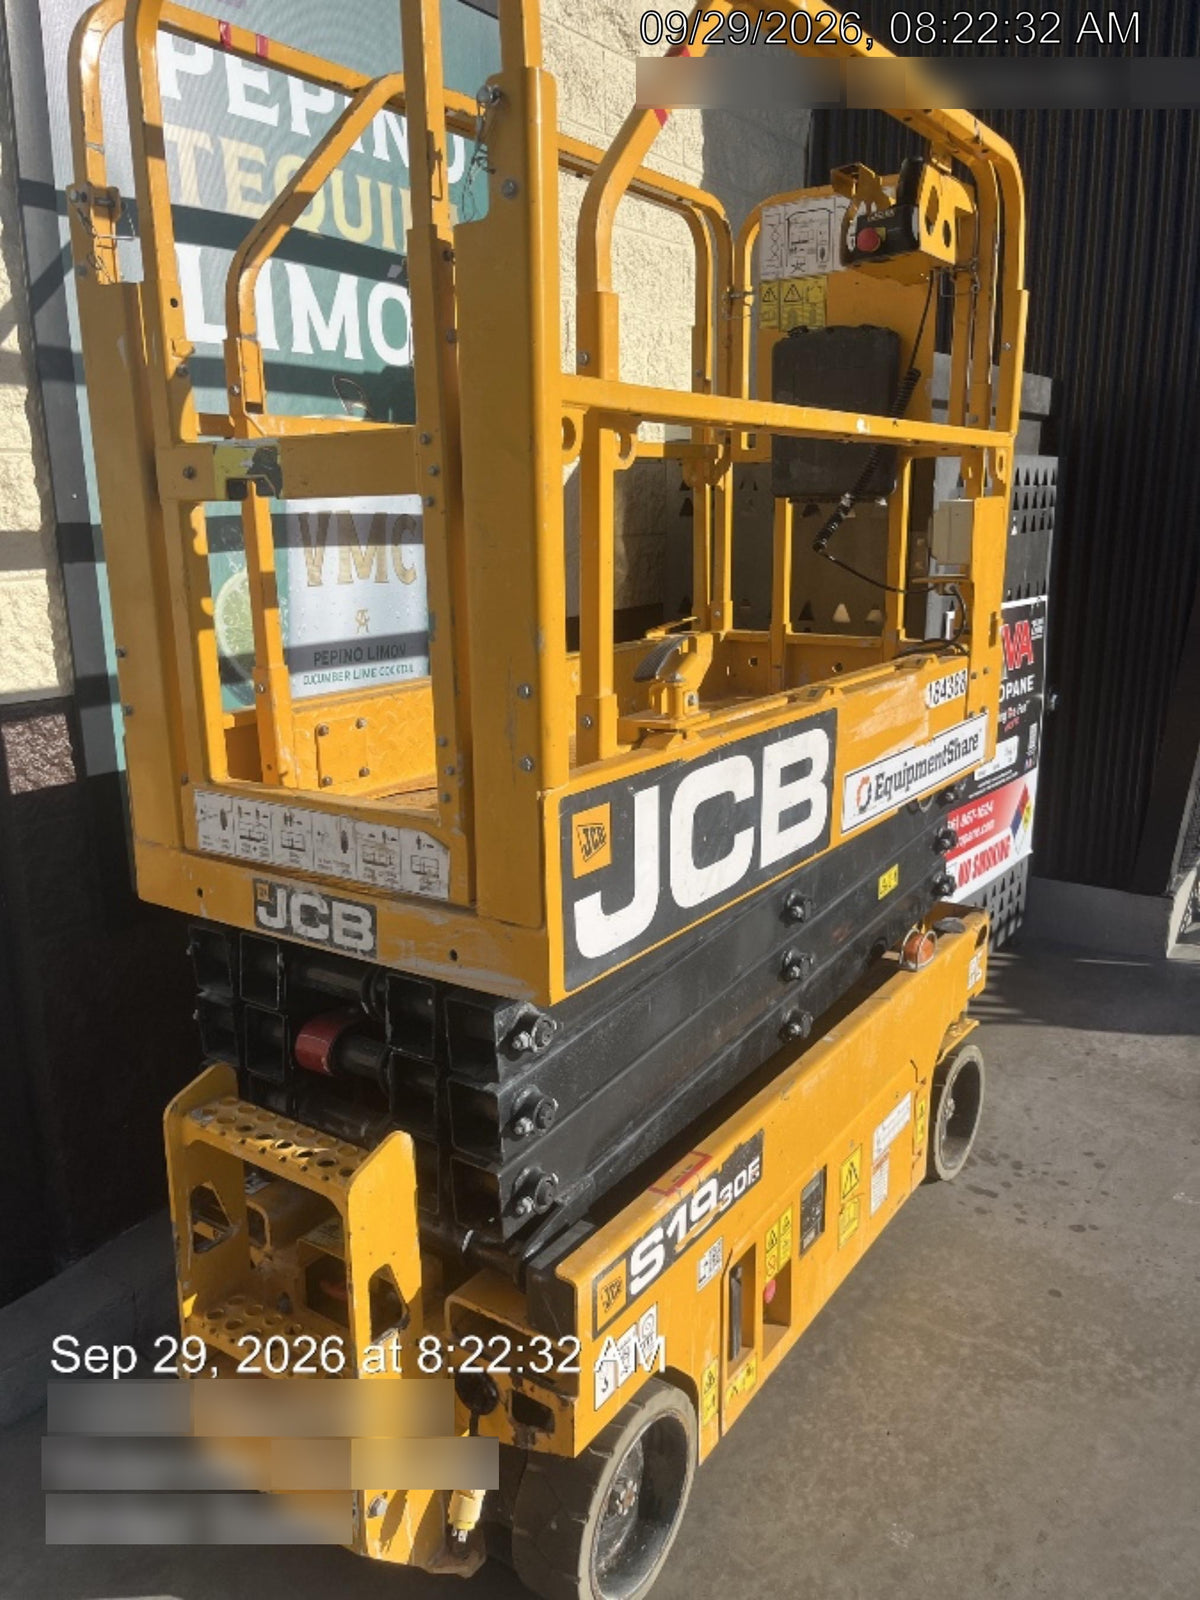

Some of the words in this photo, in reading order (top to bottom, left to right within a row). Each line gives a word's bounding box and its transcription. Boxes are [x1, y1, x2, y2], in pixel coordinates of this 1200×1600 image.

[298, 510, 417, 587] VMC
[314, 647, 363, 667] PEPINO
[874, 733, 979, 801] EquipmentShare
[574, 728, 830, 959] JCB
[582, 825, 606, 858] JCB
[256, 887, 374, 952] JCB
